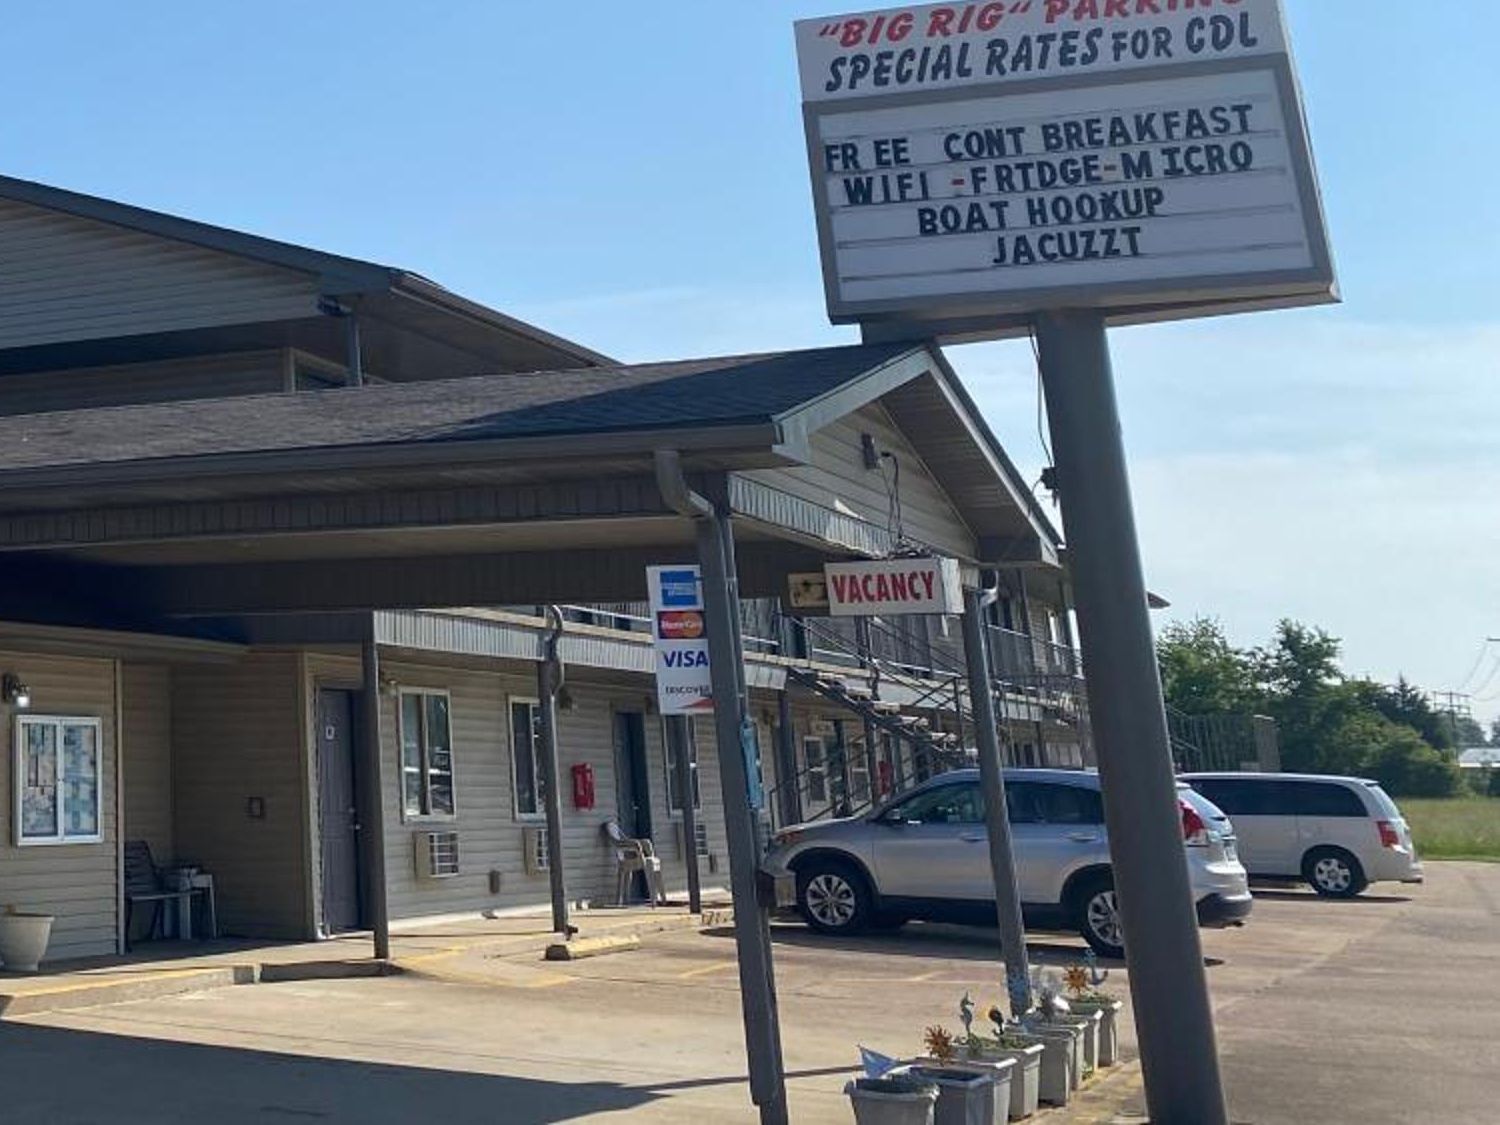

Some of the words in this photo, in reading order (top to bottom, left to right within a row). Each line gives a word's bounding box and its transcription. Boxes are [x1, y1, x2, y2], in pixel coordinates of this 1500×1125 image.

[826, 42, 972, 92] SPECIAL
[986, 27, 1103, 76] RATES
[1112, 26, 1173, 62] FOR
[1185, 11, 1258, 54] CDL
[824, 137, 911, 172] FREE
[943, 126, 1025, 161] CONT
[1041, 104, 1253, 152] BREAKFAST
[843, 171, 930, 205] WIFI
[917, 200, 1009, 237] BOAT
[1026, 186, 1165, 226] HOOKUP
[831, 569, 935, 605] VACANCY
[663, 650, 709, 668] VISA
